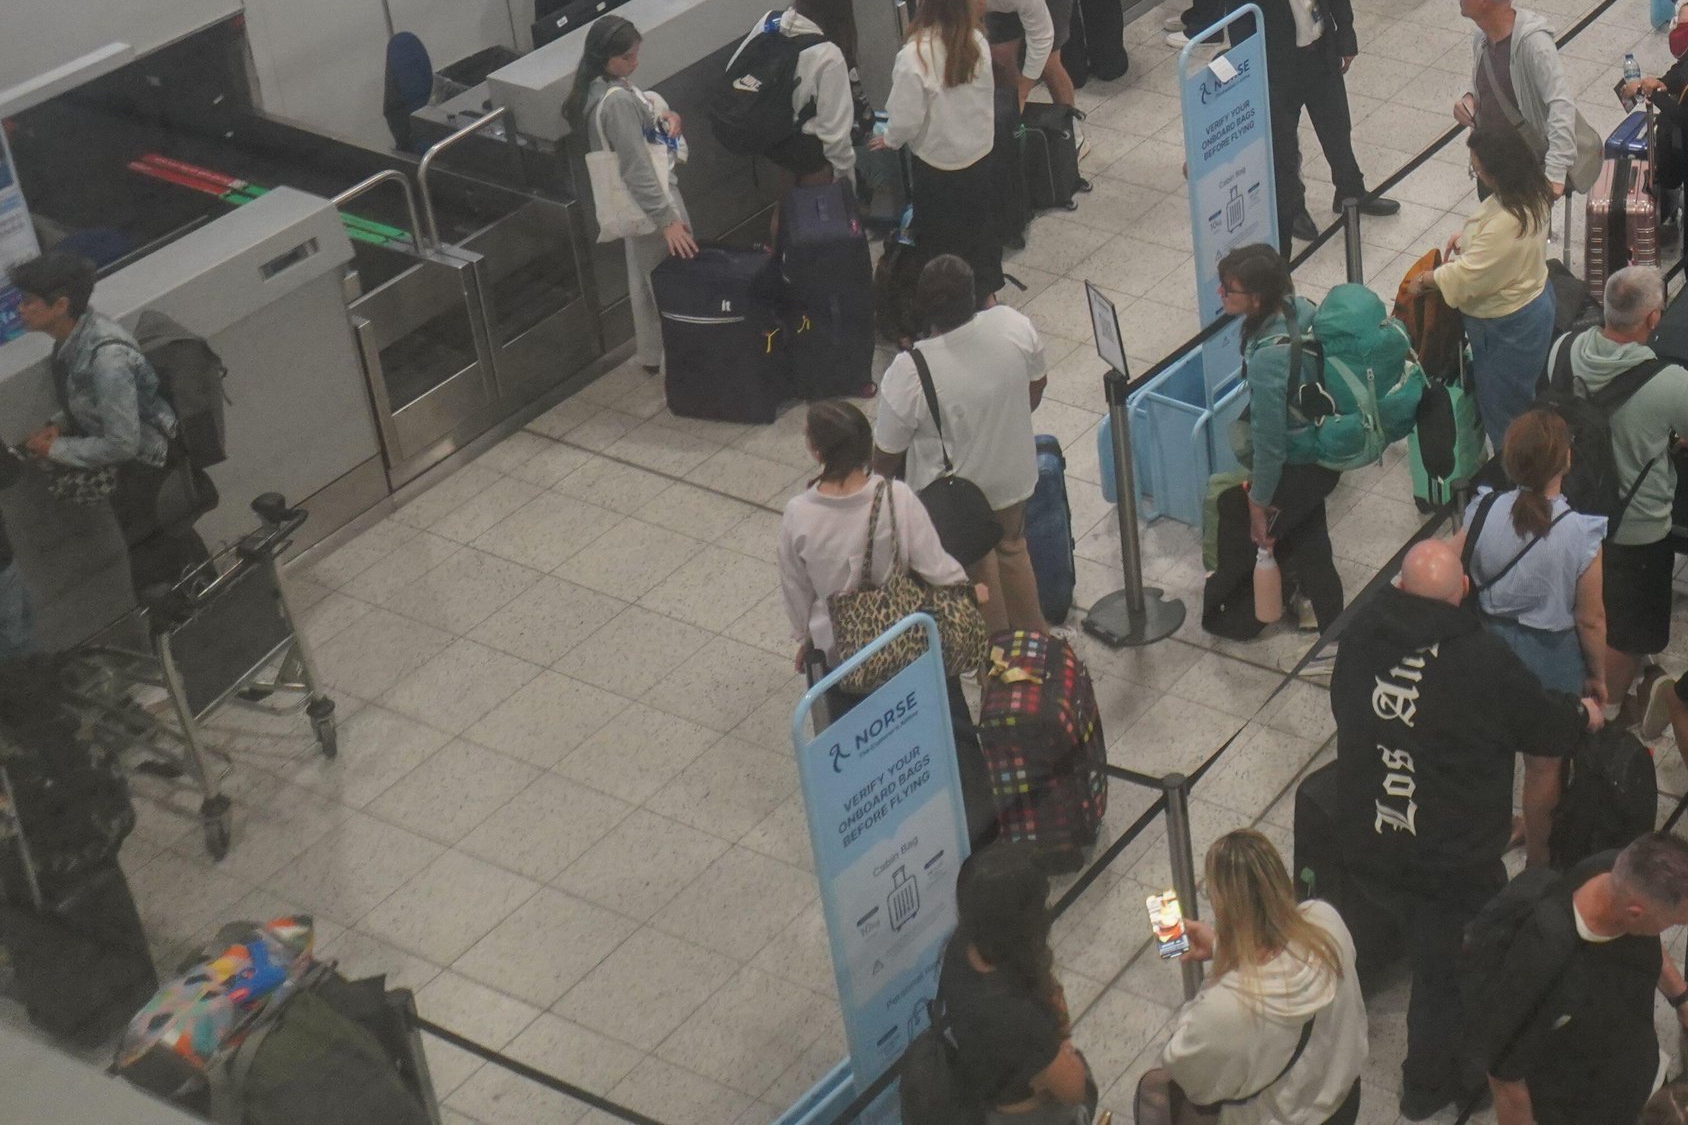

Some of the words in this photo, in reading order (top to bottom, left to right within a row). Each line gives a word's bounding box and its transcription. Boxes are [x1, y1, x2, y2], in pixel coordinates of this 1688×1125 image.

[740, 74, 763, 90] NIKE
[1201, 122, 1236, 151] ONBOARD
[1236, 108, 1256, 129] BAGS
[1203, 137, 1230, 161] BEFORE
[1230, 120, 1255, 144] FLYING
[1205, 112, 1230, 136] VERIFY
[1229, 99, 1250, 120] YOUR
[854, 691, 918, 750] NORSE
[838, 782, 897, 834] ONBOARD
[899, 754, 931, 787] BAGS
[844, 772, 885, 813] VERIFY
[887, 745, 921, 776] YOUR
[1374, 744, 1418, 837] Los
[842, 807, 889, 849] BEFORE
[890, 771, 931, 811] FLYING
[873, 850, 900, 877] Cabin
[901, 836, 919, 855] Bag
